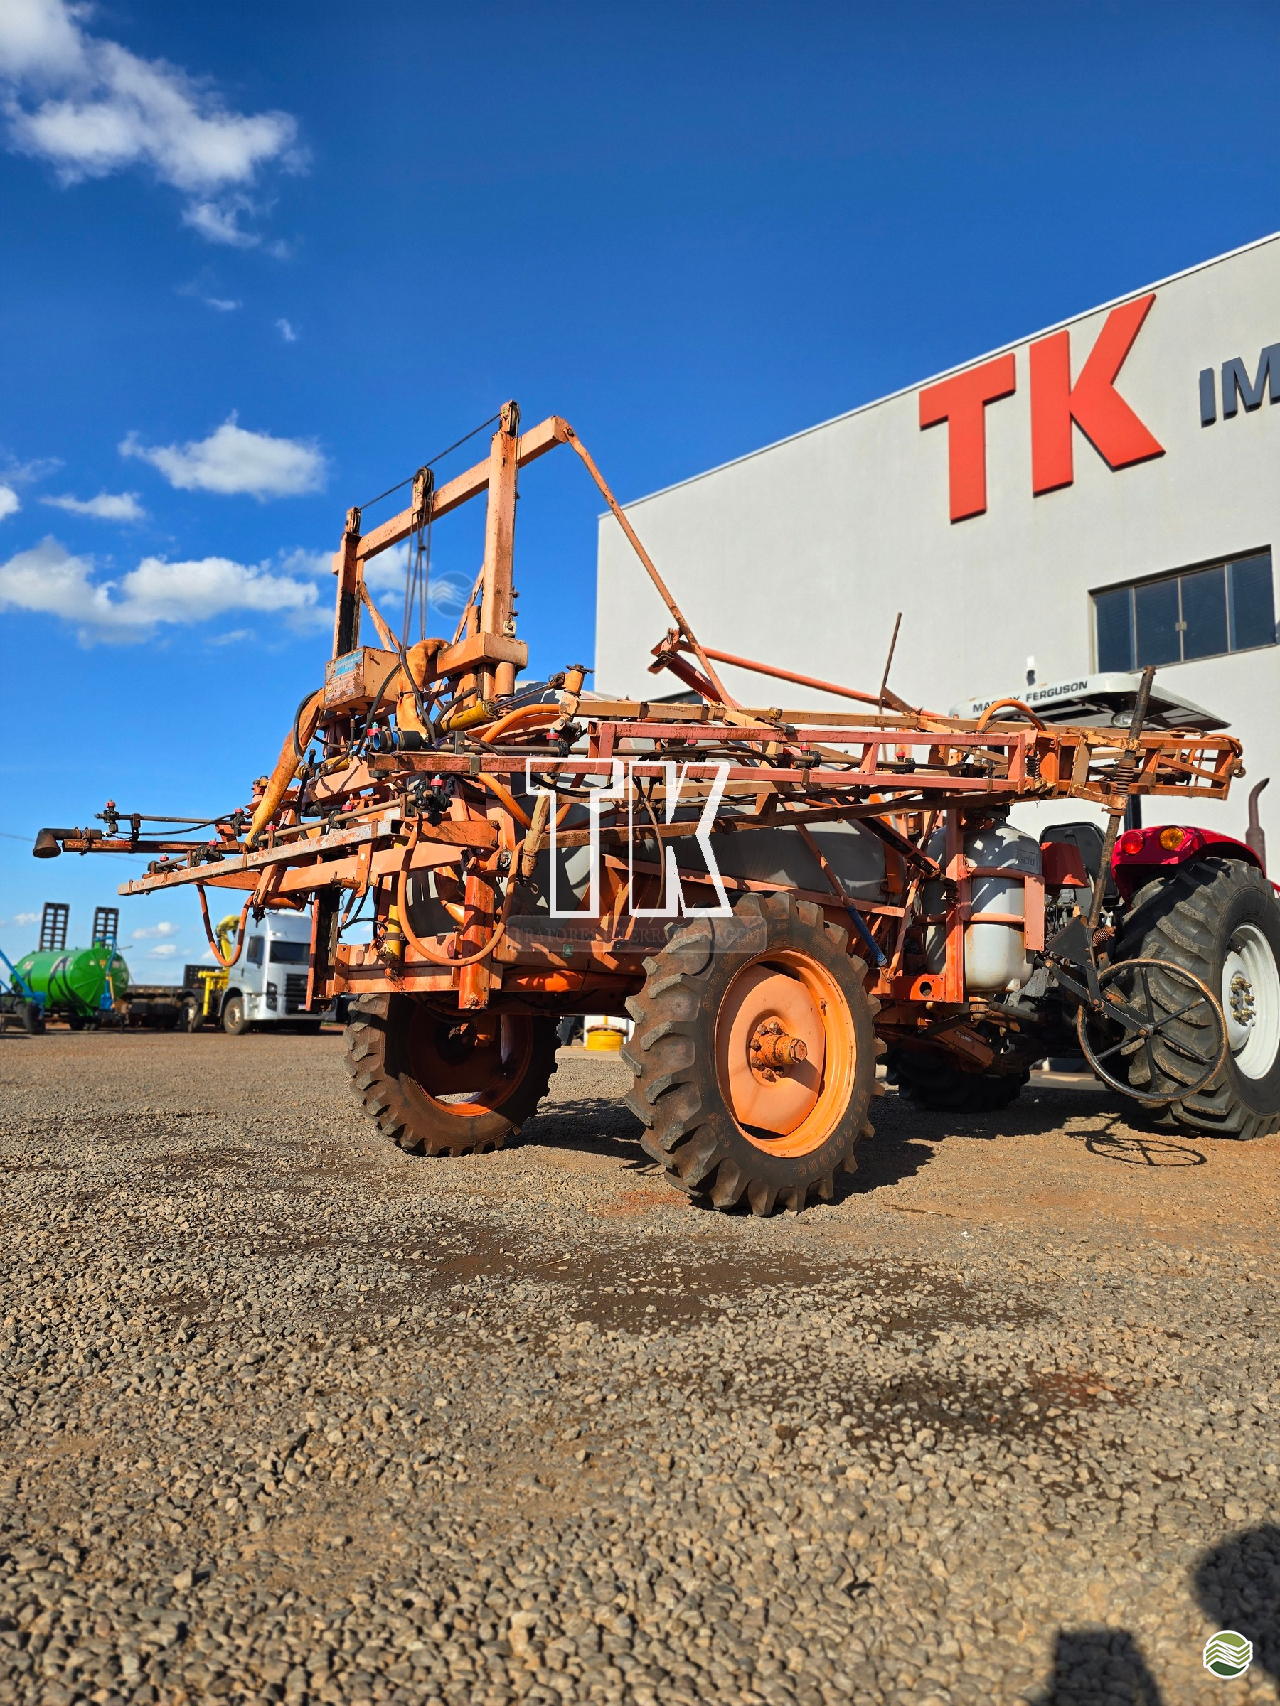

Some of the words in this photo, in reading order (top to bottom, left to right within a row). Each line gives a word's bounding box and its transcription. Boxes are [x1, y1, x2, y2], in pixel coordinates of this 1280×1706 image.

[919, 294, 1166, 525] TK
[1200, 342, 1280, 428] IM
[1026, 680, 1088, 702] FERGUSON
